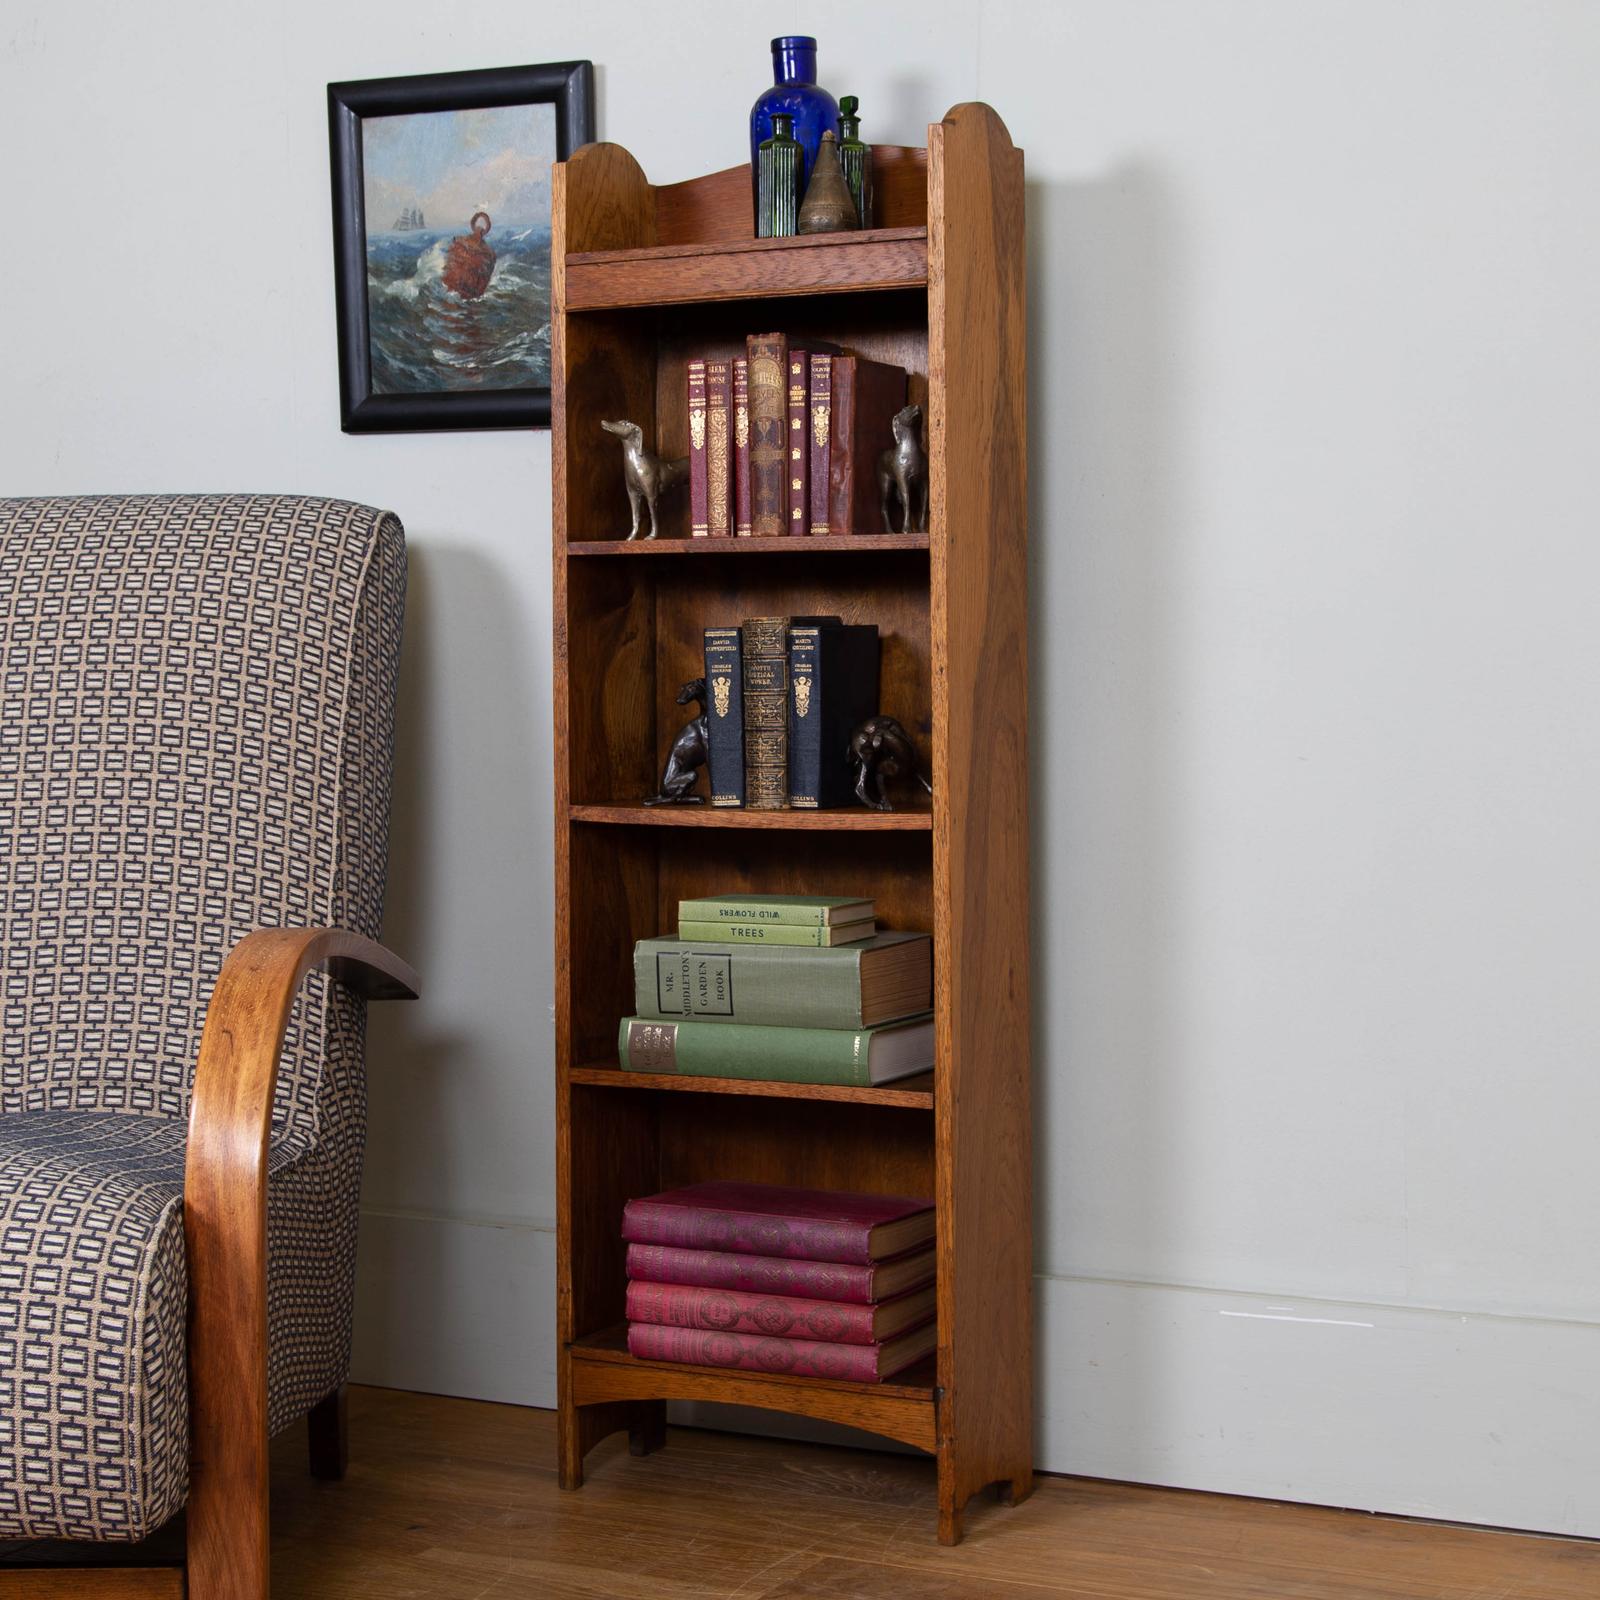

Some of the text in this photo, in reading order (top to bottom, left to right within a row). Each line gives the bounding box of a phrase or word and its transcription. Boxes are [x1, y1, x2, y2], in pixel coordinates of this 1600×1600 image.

[719, 908, 780, 918] WILD FLOWERS
[731, 927, 765, 938] TREES
[666, 972, 674, 992] MR.
[682, 950, 694, 1017] MIDDLETON'S
[698, 961, 708, 1007] GARDEN
[715, 970, 725, 1001] BOOK
